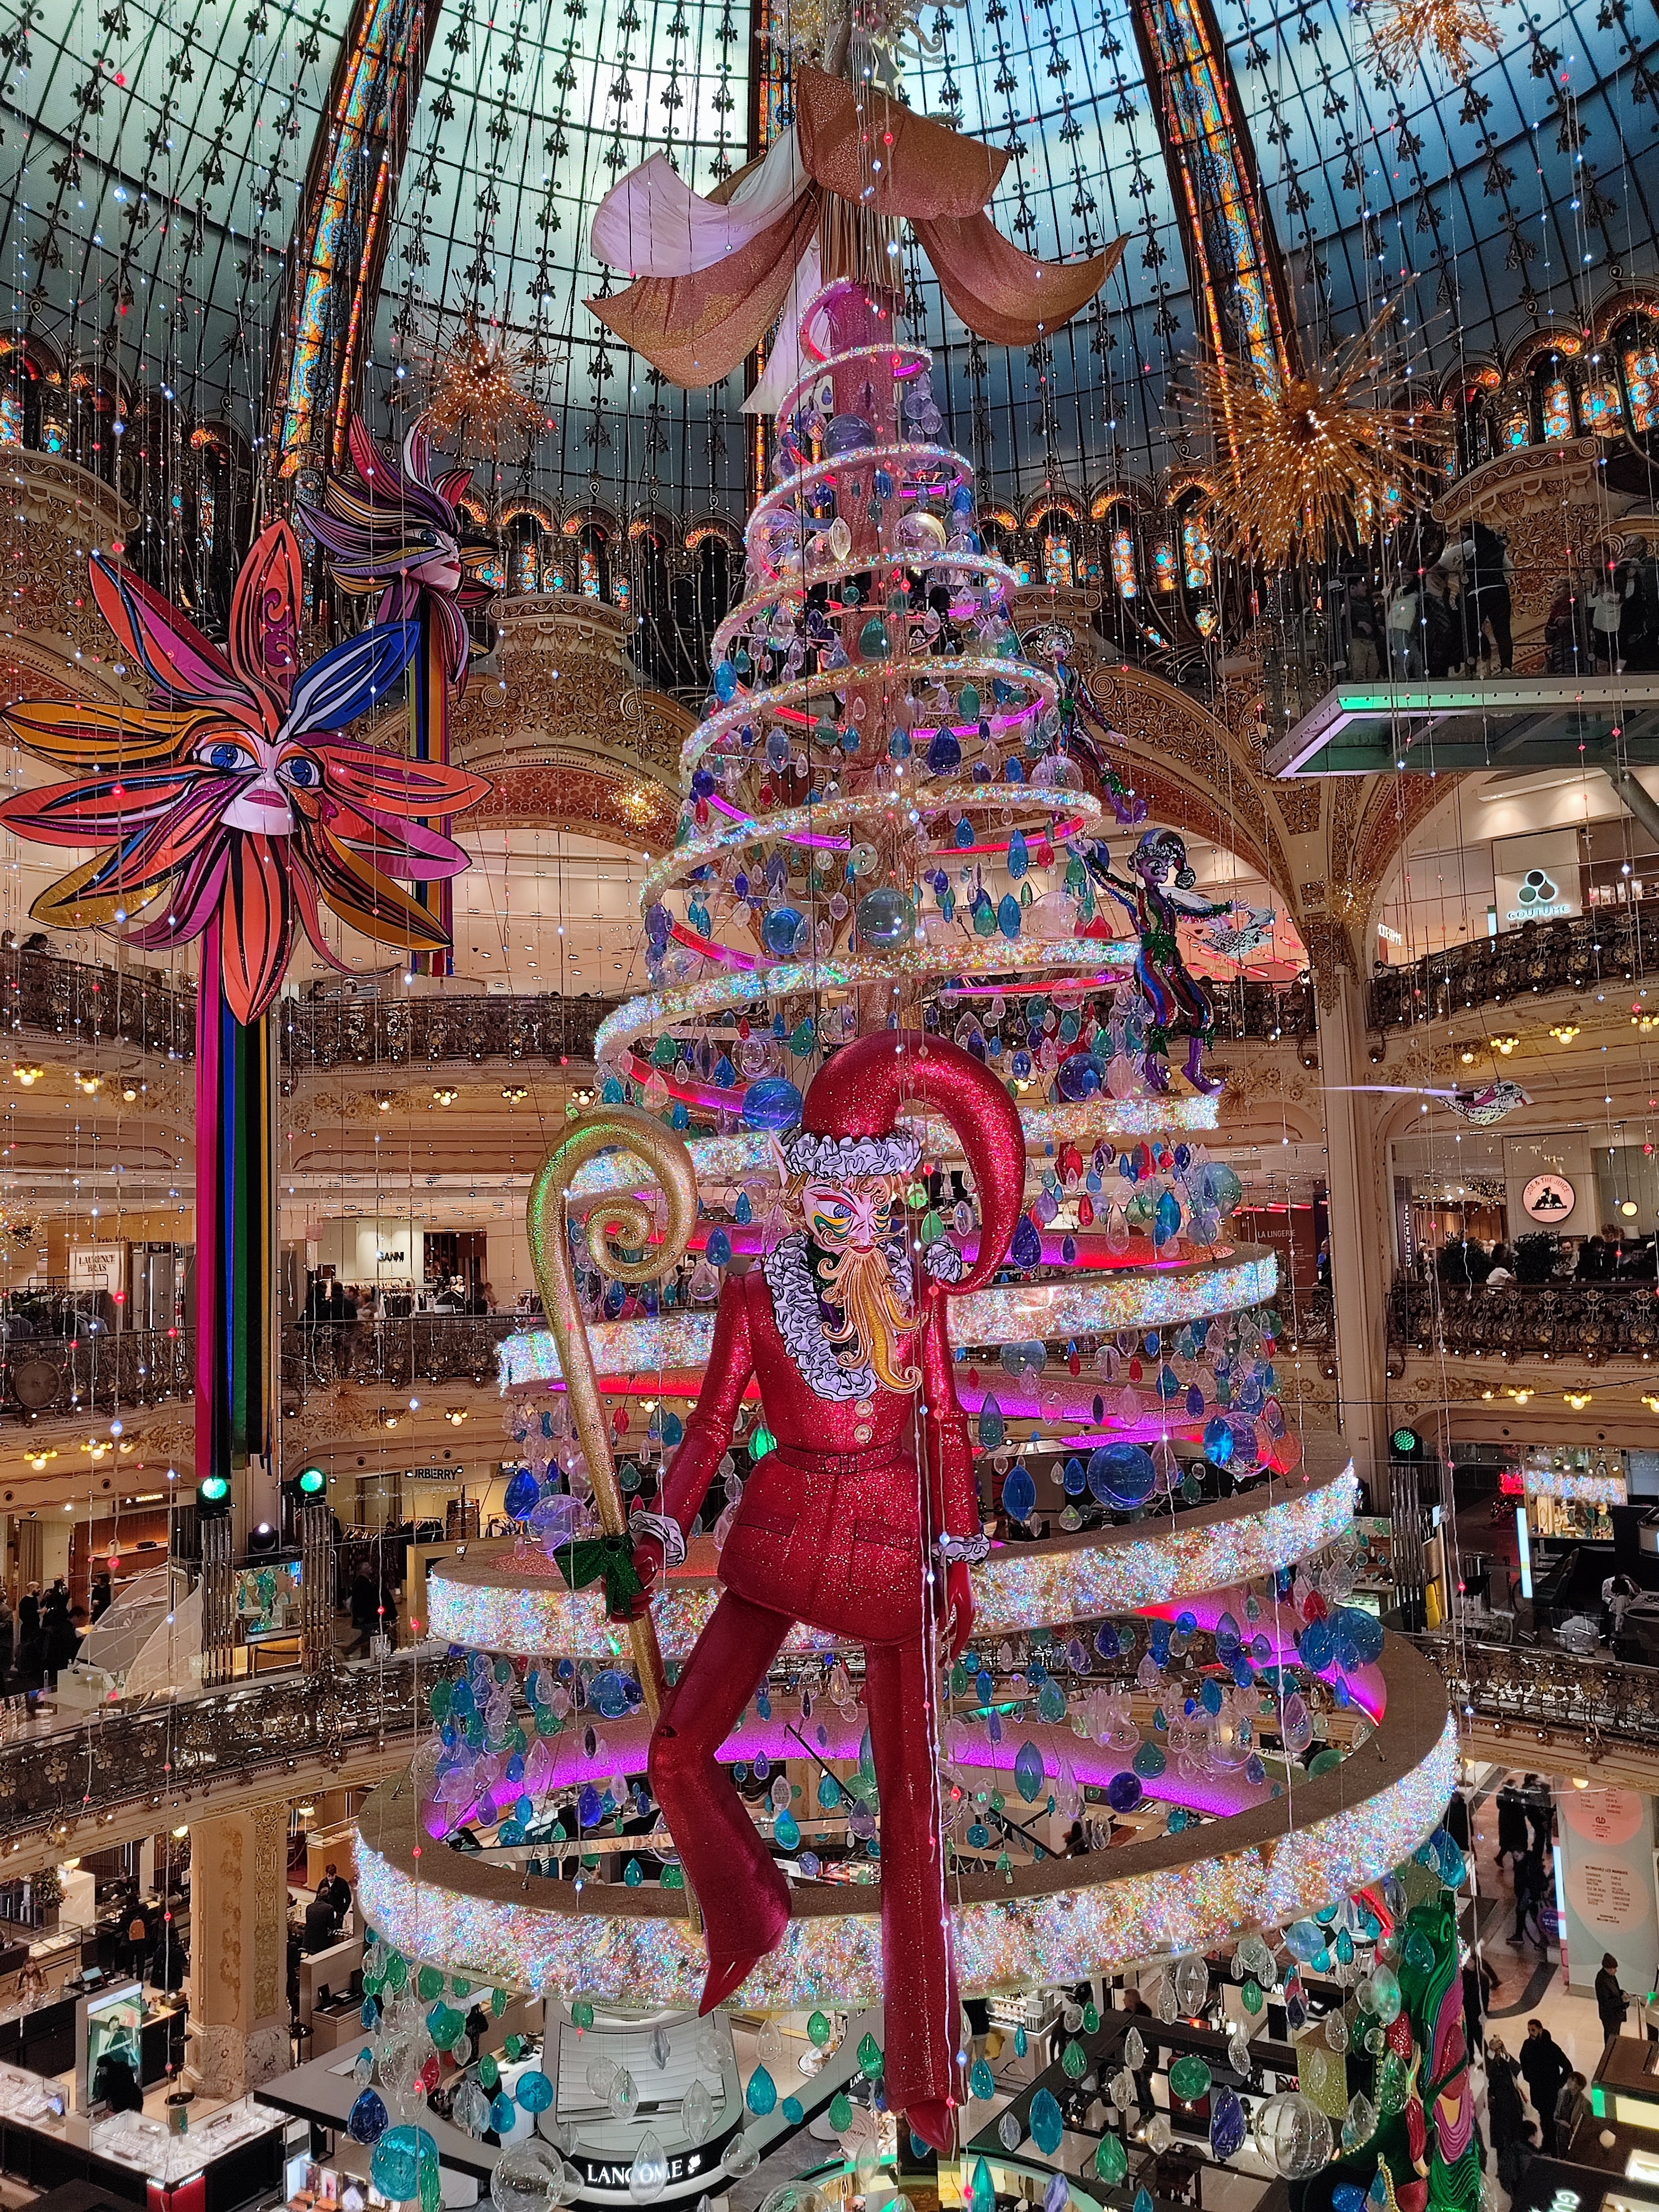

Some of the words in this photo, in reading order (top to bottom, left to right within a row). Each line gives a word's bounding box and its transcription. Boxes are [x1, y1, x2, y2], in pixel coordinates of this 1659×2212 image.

[1508, 905, 1571, 919] COUTUME
[1527, 1183, 1536, 1195] JOE
[1553, 1179, 1570, 1194] JUICE
[79, 1254, 116, 1265] LAURENCE
